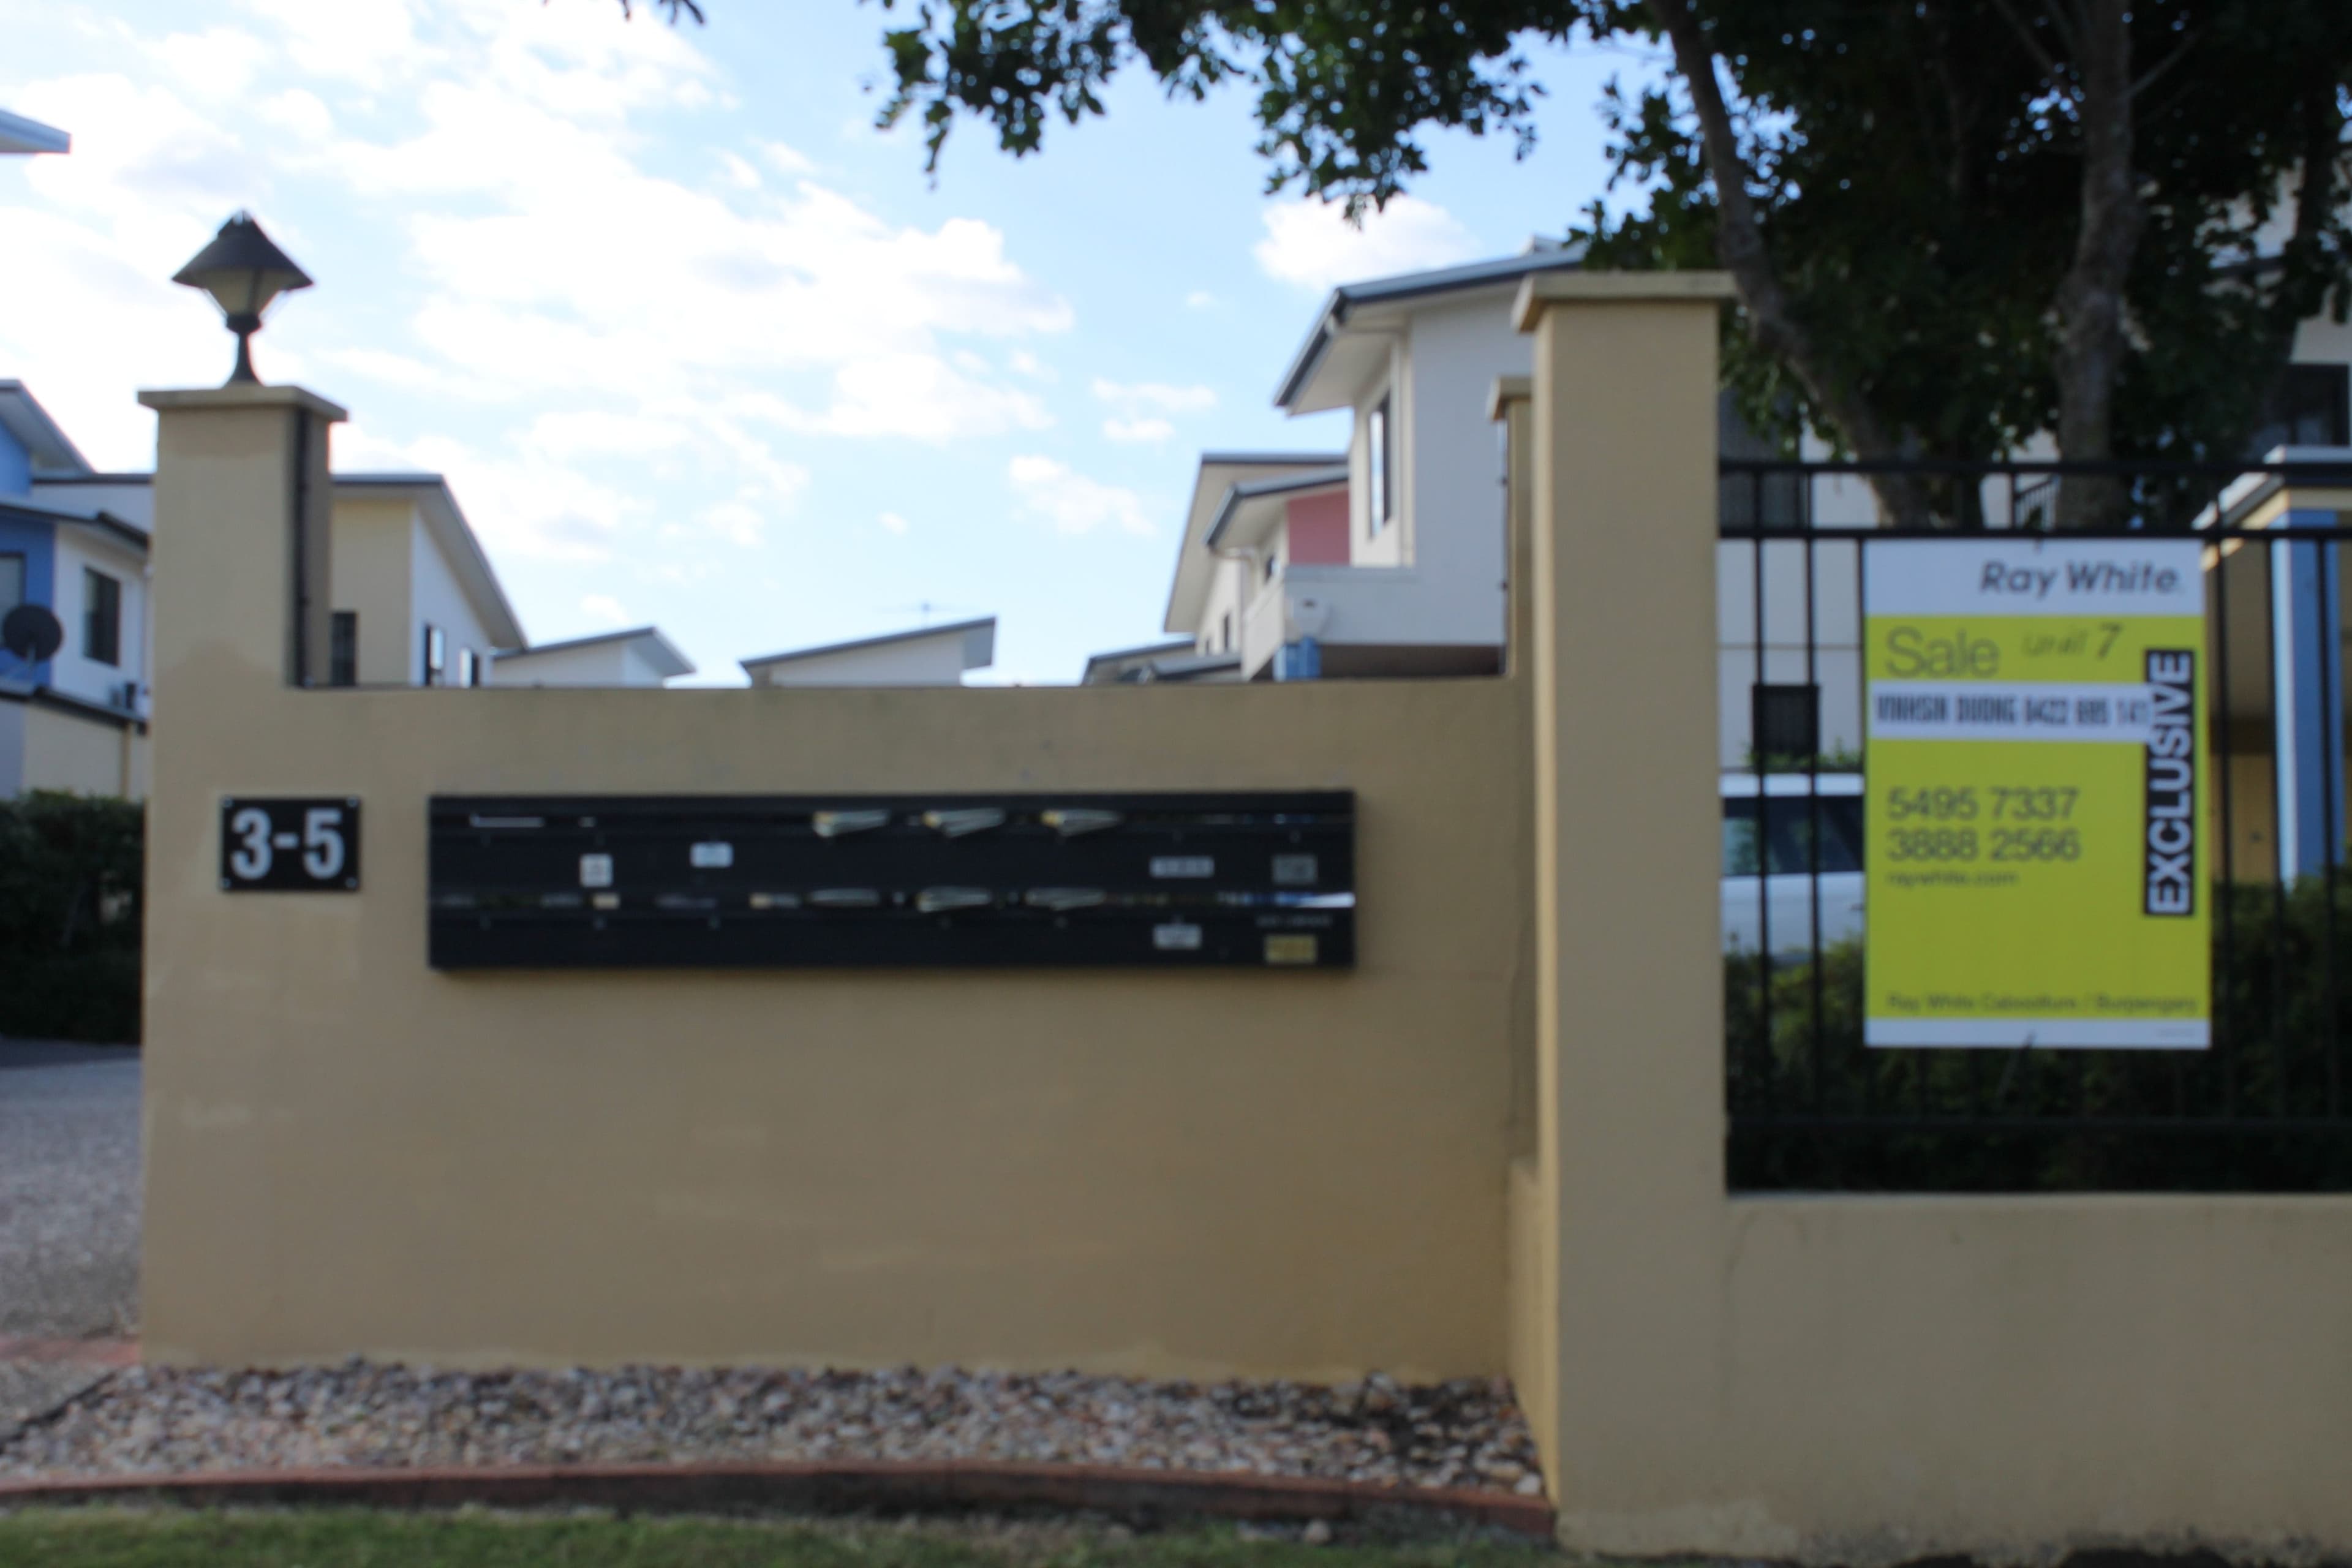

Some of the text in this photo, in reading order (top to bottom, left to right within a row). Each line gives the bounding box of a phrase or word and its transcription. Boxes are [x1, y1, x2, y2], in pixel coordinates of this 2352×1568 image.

[1980, 561, 2059, 599] Ray
[1885, 625, 2000, 679] Sale
[2096, 621, 2124, 660] 7
[2148, 652, 2193, 914] EXCLUSIVE
[1887, 787, 2079, 821] 5495 7337
[230, 807, 345, 880] 3-5
[1887, 827, 2081, 862] 3888 2566
[1887, 870, 2018, 890] raywhite.com
[1887, 992, 1921, 1013] Ray
[1925, 992, 1977, 1010] White
